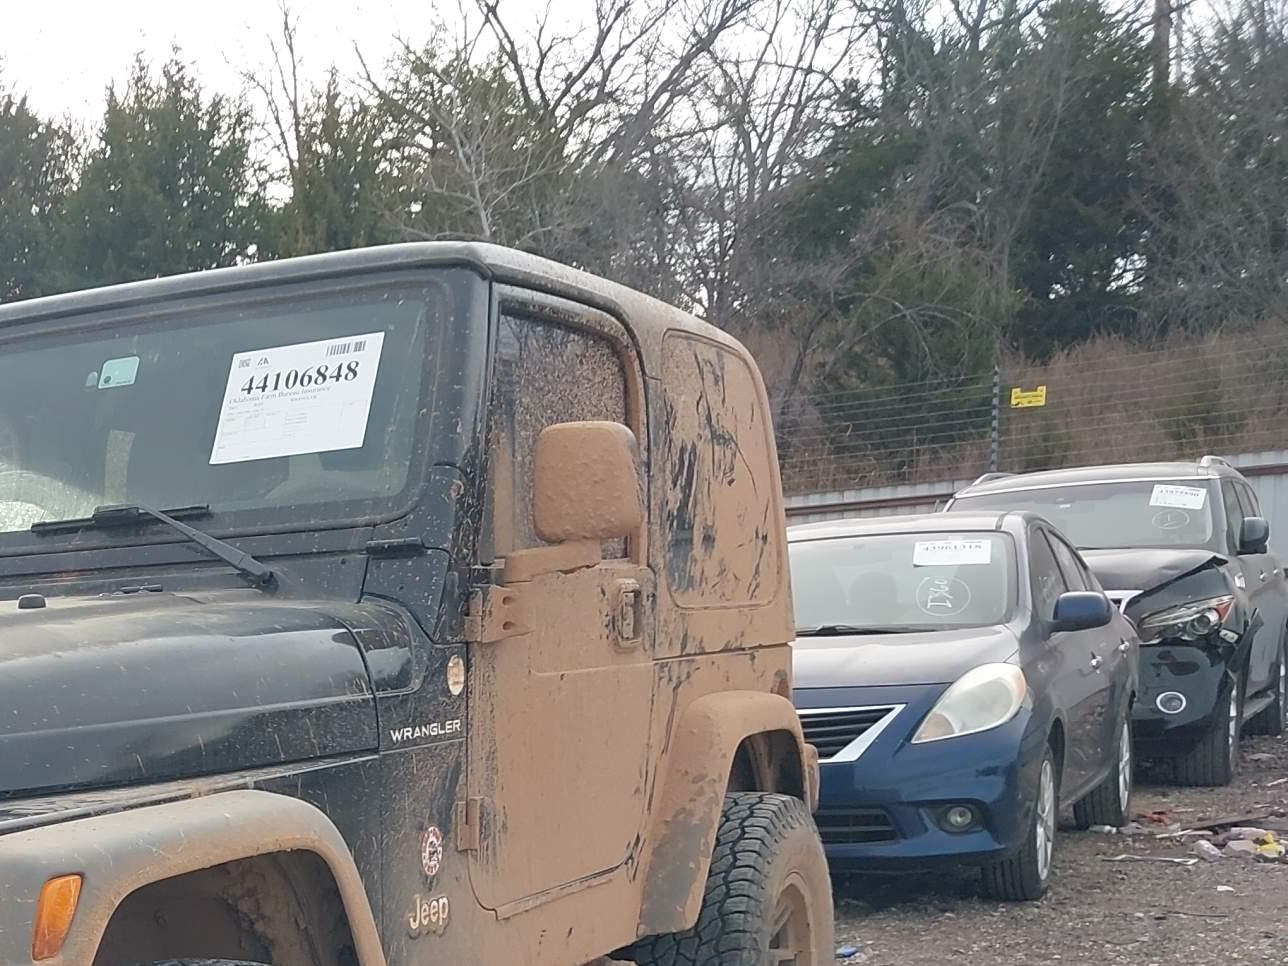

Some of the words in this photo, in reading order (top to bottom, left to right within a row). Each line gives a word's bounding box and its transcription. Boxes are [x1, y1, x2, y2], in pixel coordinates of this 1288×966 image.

[240, 360, 360, 395] 44106848
[390, 719, 461, 743] WRANGLER
[408, 894, 449, 931] Jeep
